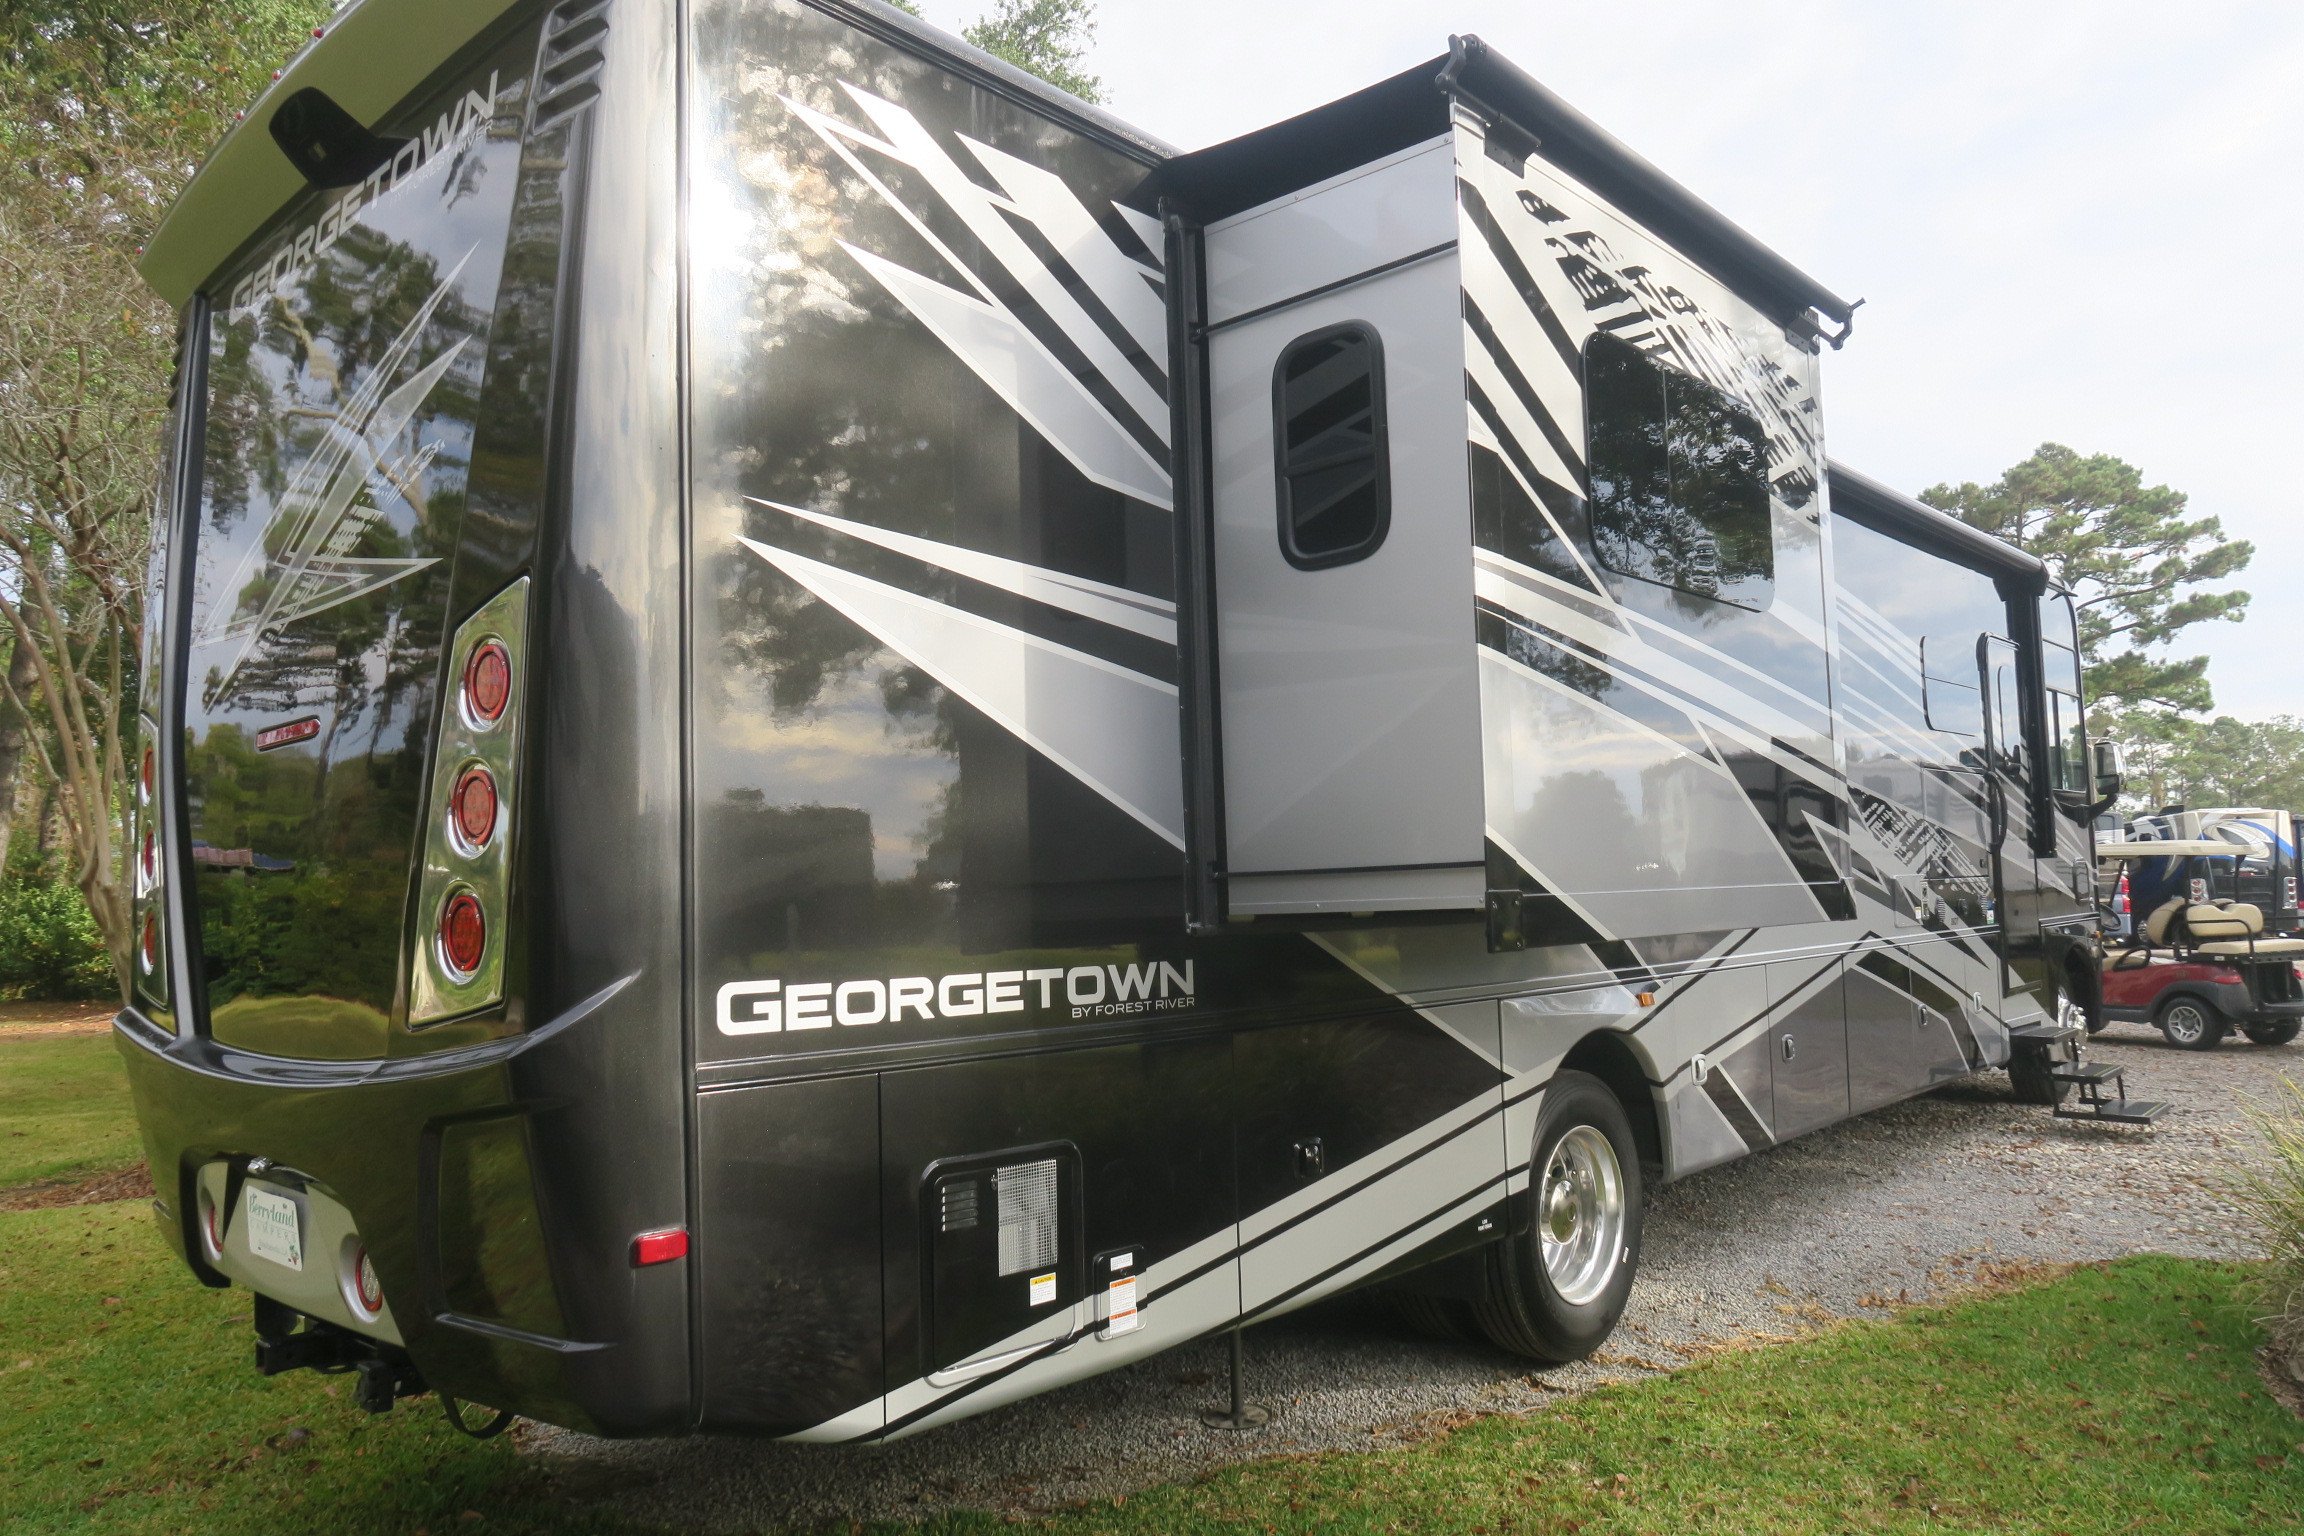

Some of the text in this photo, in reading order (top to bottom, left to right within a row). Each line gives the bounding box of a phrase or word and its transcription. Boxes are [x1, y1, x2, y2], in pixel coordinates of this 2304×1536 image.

[229, 69, 498, 326] GEORGETOWN
[716, 958, 1195, 1036] GEORGETOWN
[1071, 997, 1195, 1019] BY FOREST RIVER
[249, 1193, 295, 1228] Berryland
